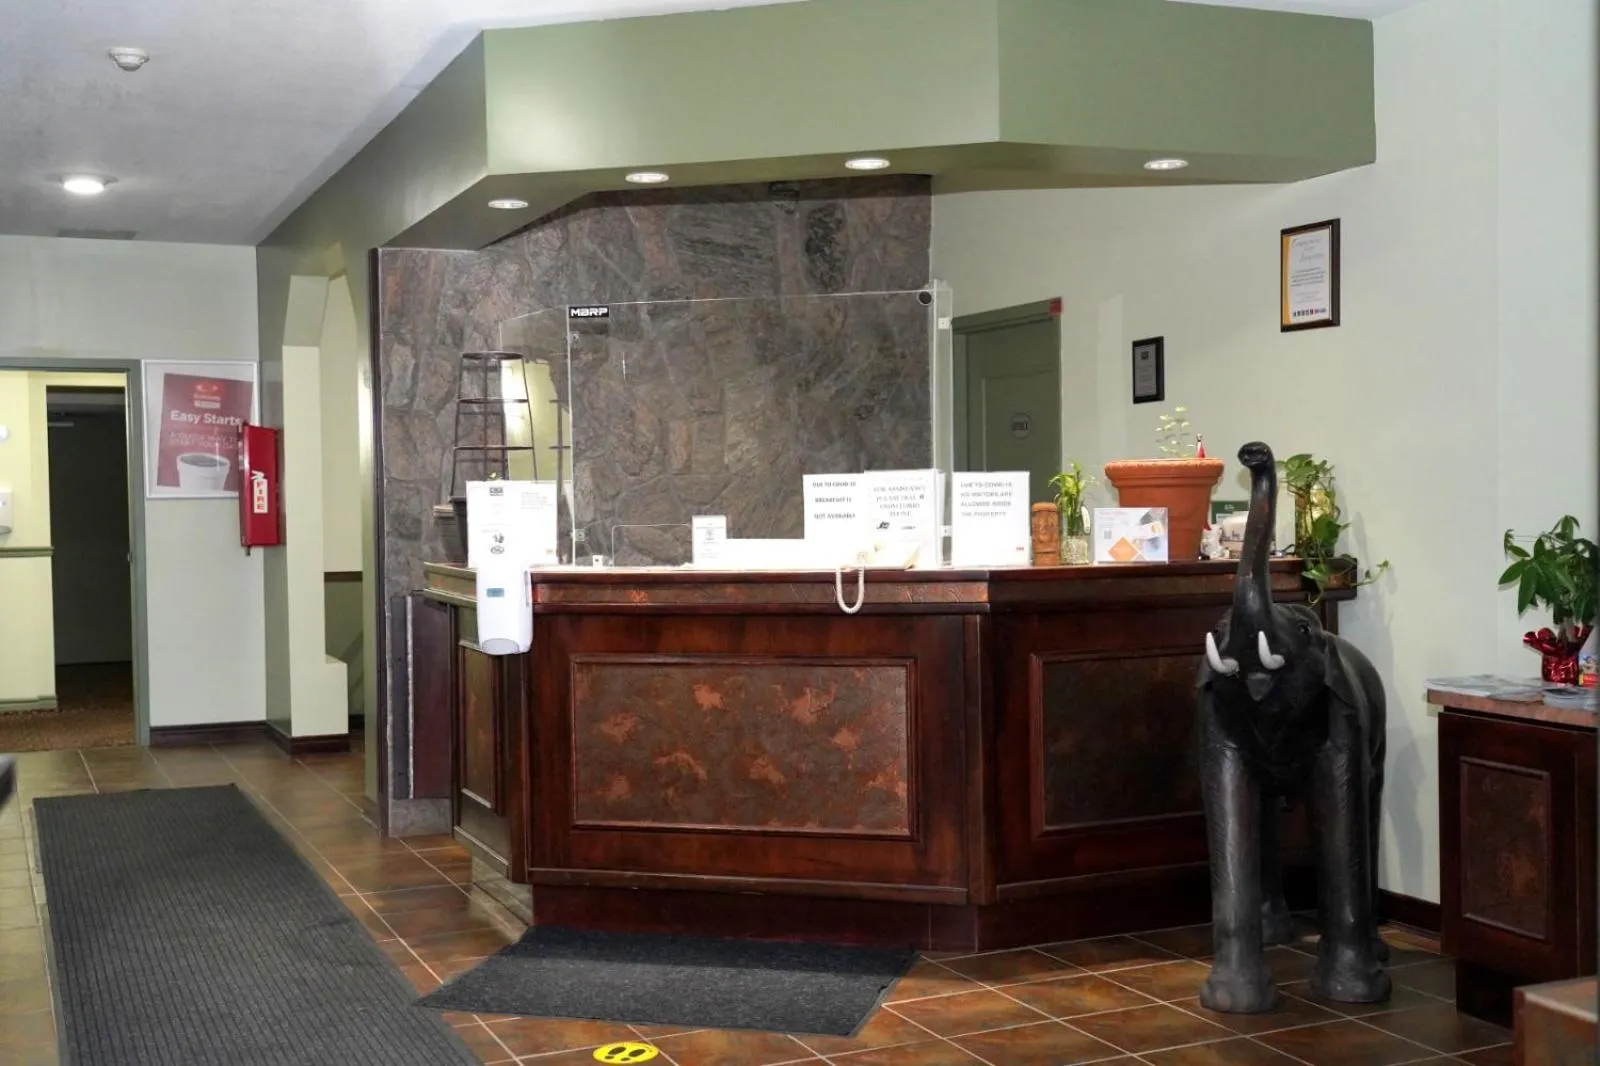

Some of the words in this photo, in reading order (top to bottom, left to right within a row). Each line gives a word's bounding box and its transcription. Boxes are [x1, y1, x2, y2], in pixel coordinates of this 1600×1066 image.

[570, 307, 608, 317] MBRP
[170, 410, 201, 425] Easy
[203, 413, 242, 426] Starts
[256, 481, 265, 510] FIRE
